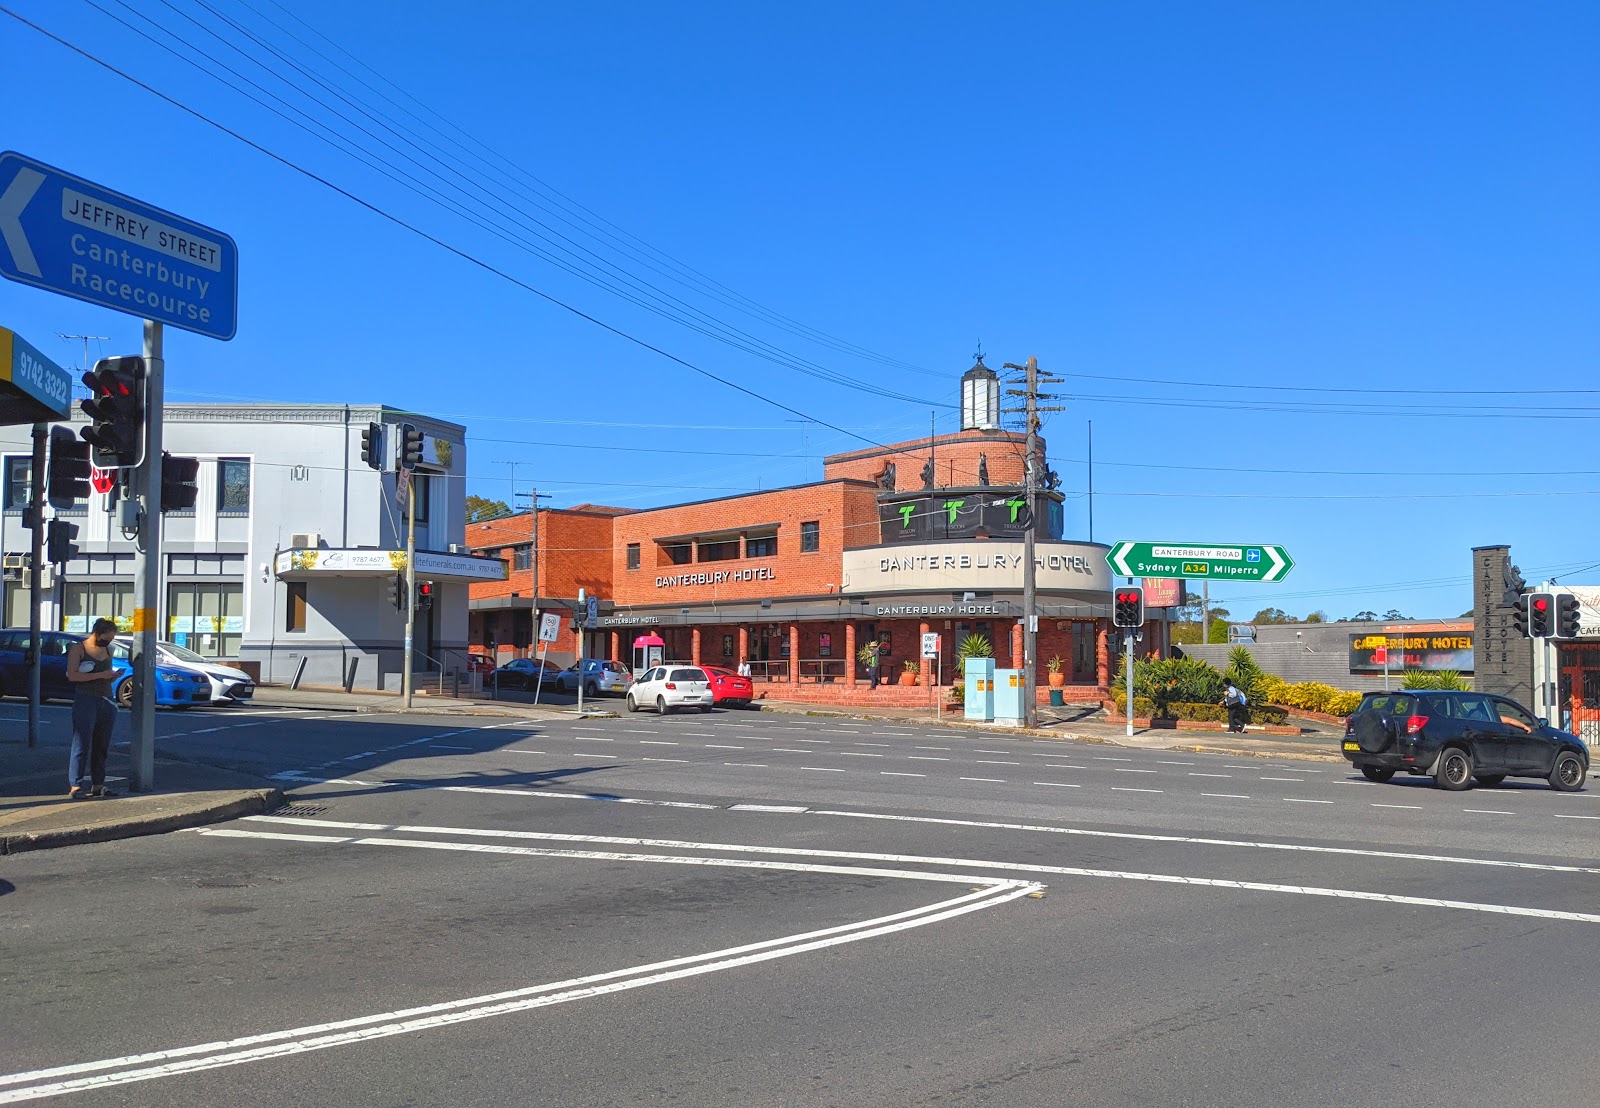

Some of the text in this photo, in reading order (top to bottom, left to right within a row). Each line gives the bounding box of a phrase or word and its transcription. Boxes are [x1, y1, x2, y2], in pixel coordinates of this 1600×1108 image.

[69, 199, 216, 264] JEFFREY STREET
[70, 233, 209, 299] Canterbury
[71, 264, 211, 323] Racecourse
[20, 351, 67, 405] 9742 3322
[1154, 549, 1212, 557] CANTERBURY
[414, 557, 476, 572] litefunerals.com.au
[879, 553, 1092, 572] CANTERBURY HOTEL
[1137, 562, 1258, 575] Sydney A34 Milperra
[655, 567, 775, 588] CANTERBURY HOTEL
[1146, 577, 1164, 589] VIP
[1158, 588, 1176, 597] Lounge
[877, 604, 999, 615] CANTERBURY HOTEL
[604, 616, 640, 626] CANTERBURY
[640, 616, 660, 625] HOTEL
[1432, 636, 1473, 649] HOTEL
